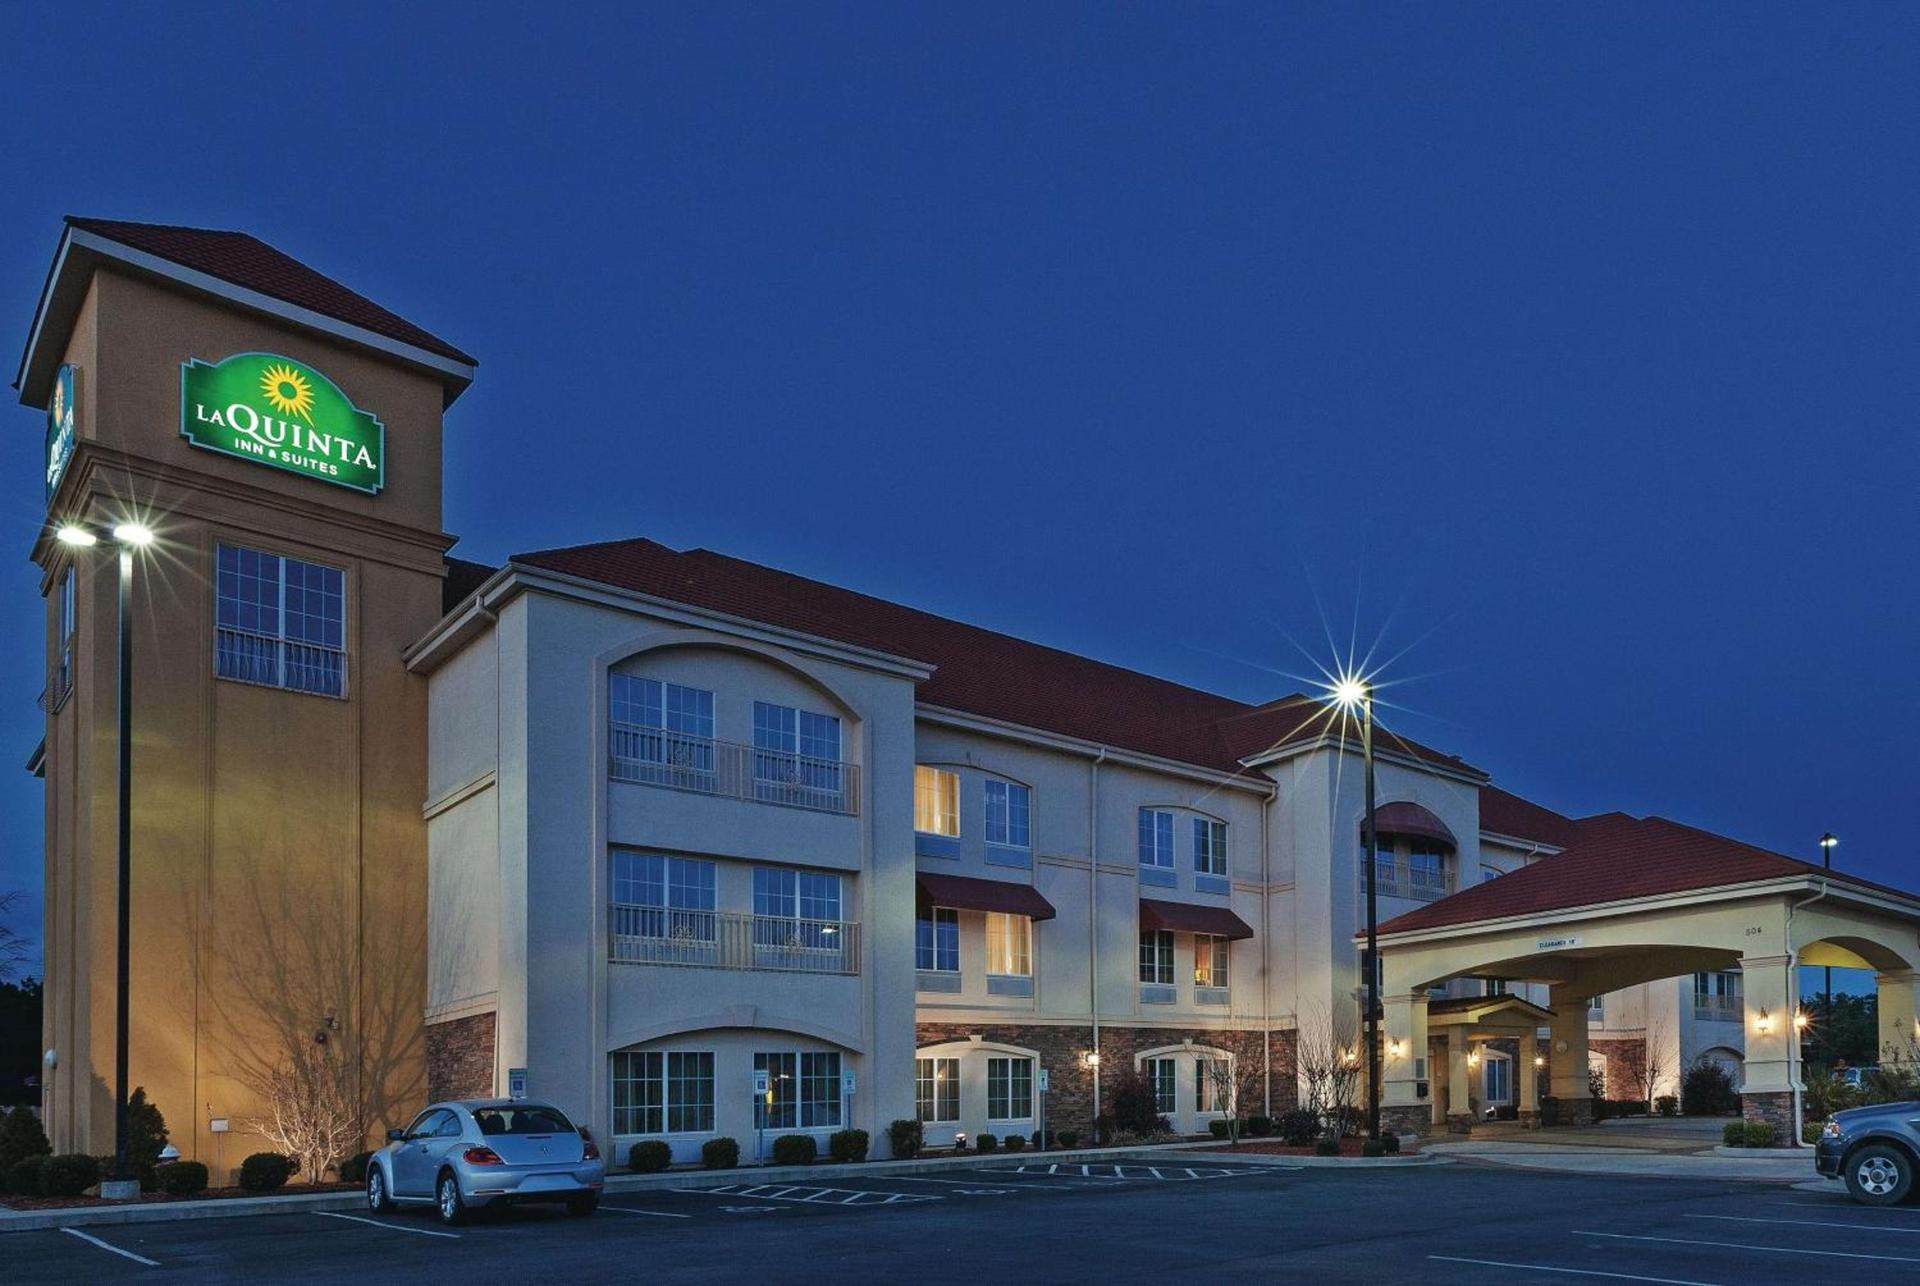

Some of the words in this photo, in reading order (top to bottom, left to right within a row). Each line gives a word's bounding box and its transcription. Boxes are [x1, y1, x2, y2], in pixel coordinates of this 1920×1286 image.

[197, 404, 226, 428] LA
[226, 403, 373, 470] QUINTA
[235, 438, 264, 456] INN
[268, 449, 278, 459] &
[281, 450, 338, 475] SUITES
